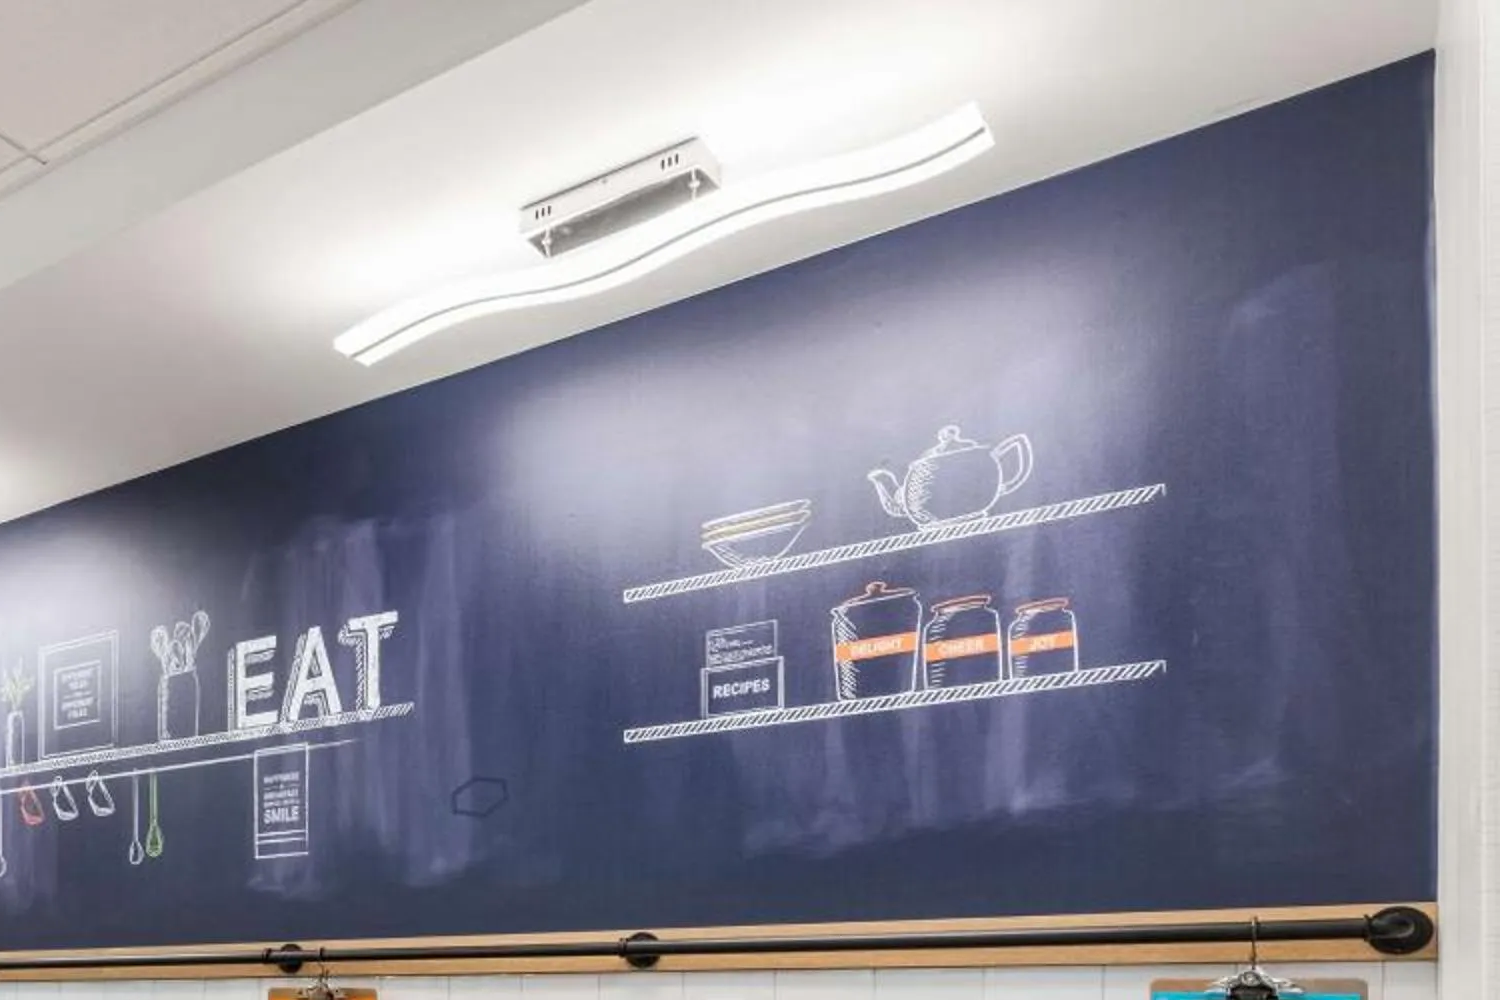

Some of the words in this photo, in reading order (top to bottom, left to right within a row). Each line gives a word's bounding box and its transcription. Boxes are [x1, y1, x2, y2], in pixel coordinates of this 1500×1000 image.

[850, 637, 903, 657] DELIGHT
[1029, 636, 1054, 651] JOY
[228, 610, 398, 731] EAT
[713, 678, 770, 699] RECIPES
[263, 805, 299, 824] SMILE
